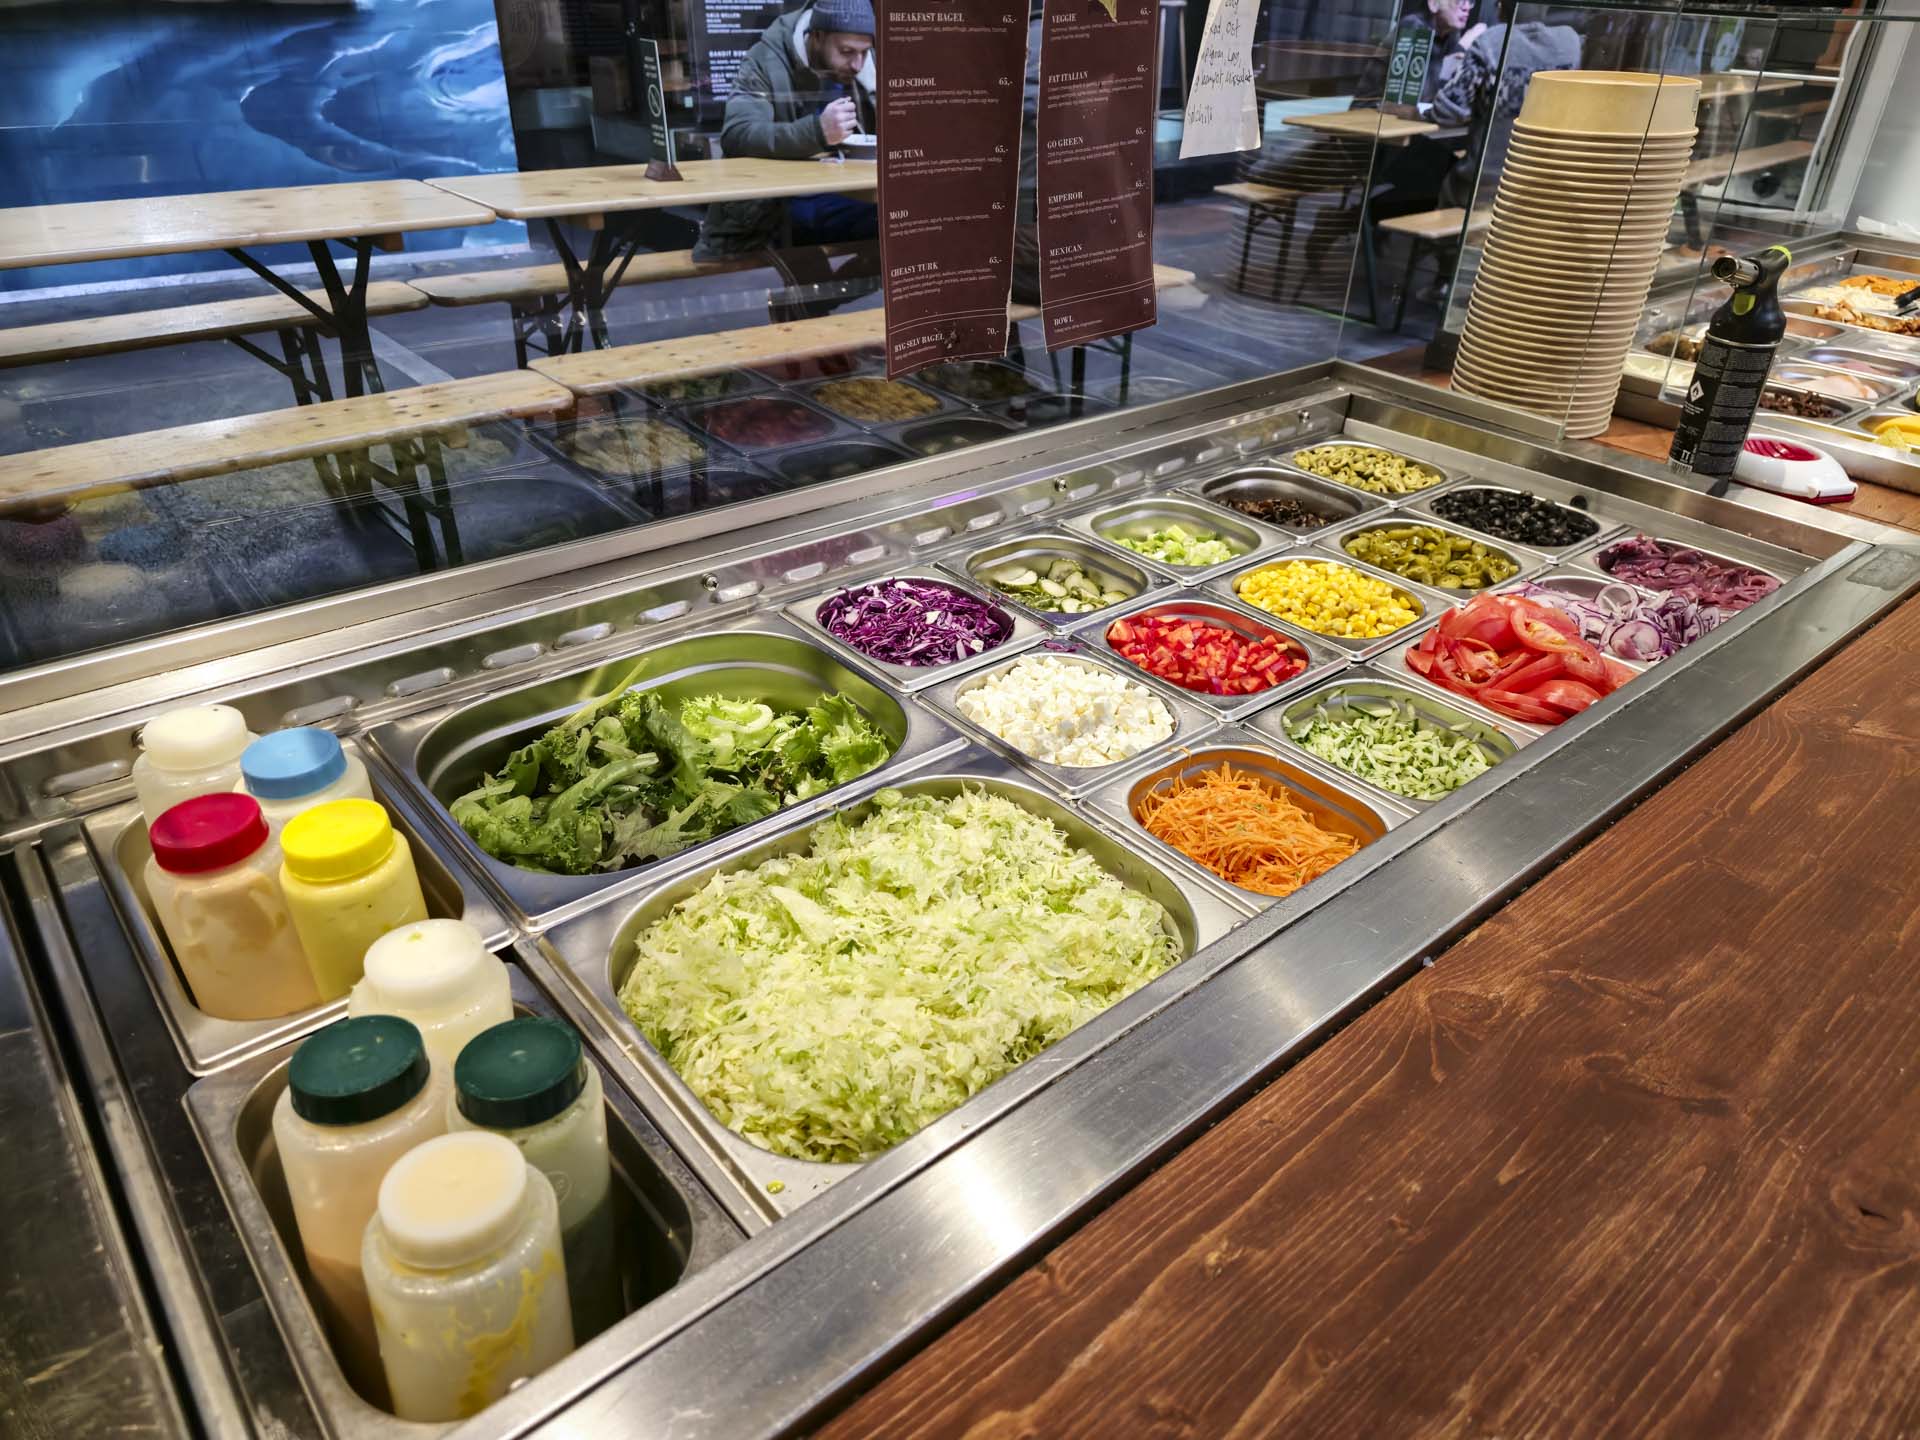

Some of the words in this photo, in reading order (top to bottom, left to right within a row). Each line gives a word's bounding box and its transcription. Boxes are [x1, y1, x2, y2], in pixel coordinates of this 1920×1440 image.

[889, 12, 936, 22] BREAKFAST
[937, 12, 964, 22] BAGEL
[1051, 13, 1077, 23] VEGGIE
[1048, 73, 1061, 83] FAT
[1061, 71, 1088, 82] ITALIAN
[889, 79, 905, 88] OLD
[906, 78, 936, 87] SCHOOL
[1047, 140, 1057, 149] GO
[1057, 136, 1084, 147] GREEN
[889, 150, 902, 160] BIG
[903, 149, 924, 158] TUNA
[1048, 191, 1083, 204] EMPEROR
[889, 210, 909, 220] MOJO
[1049, 244, 1083, 257] MEXICAN
[891, 264, 916, 277] CHEASY
[917, 262, 938, 273] TURK
[1054, 315, 1074, 326] BOWL
[894, 342, 906, 353] BYG
[921, 333, 945, 345] BAGEL
